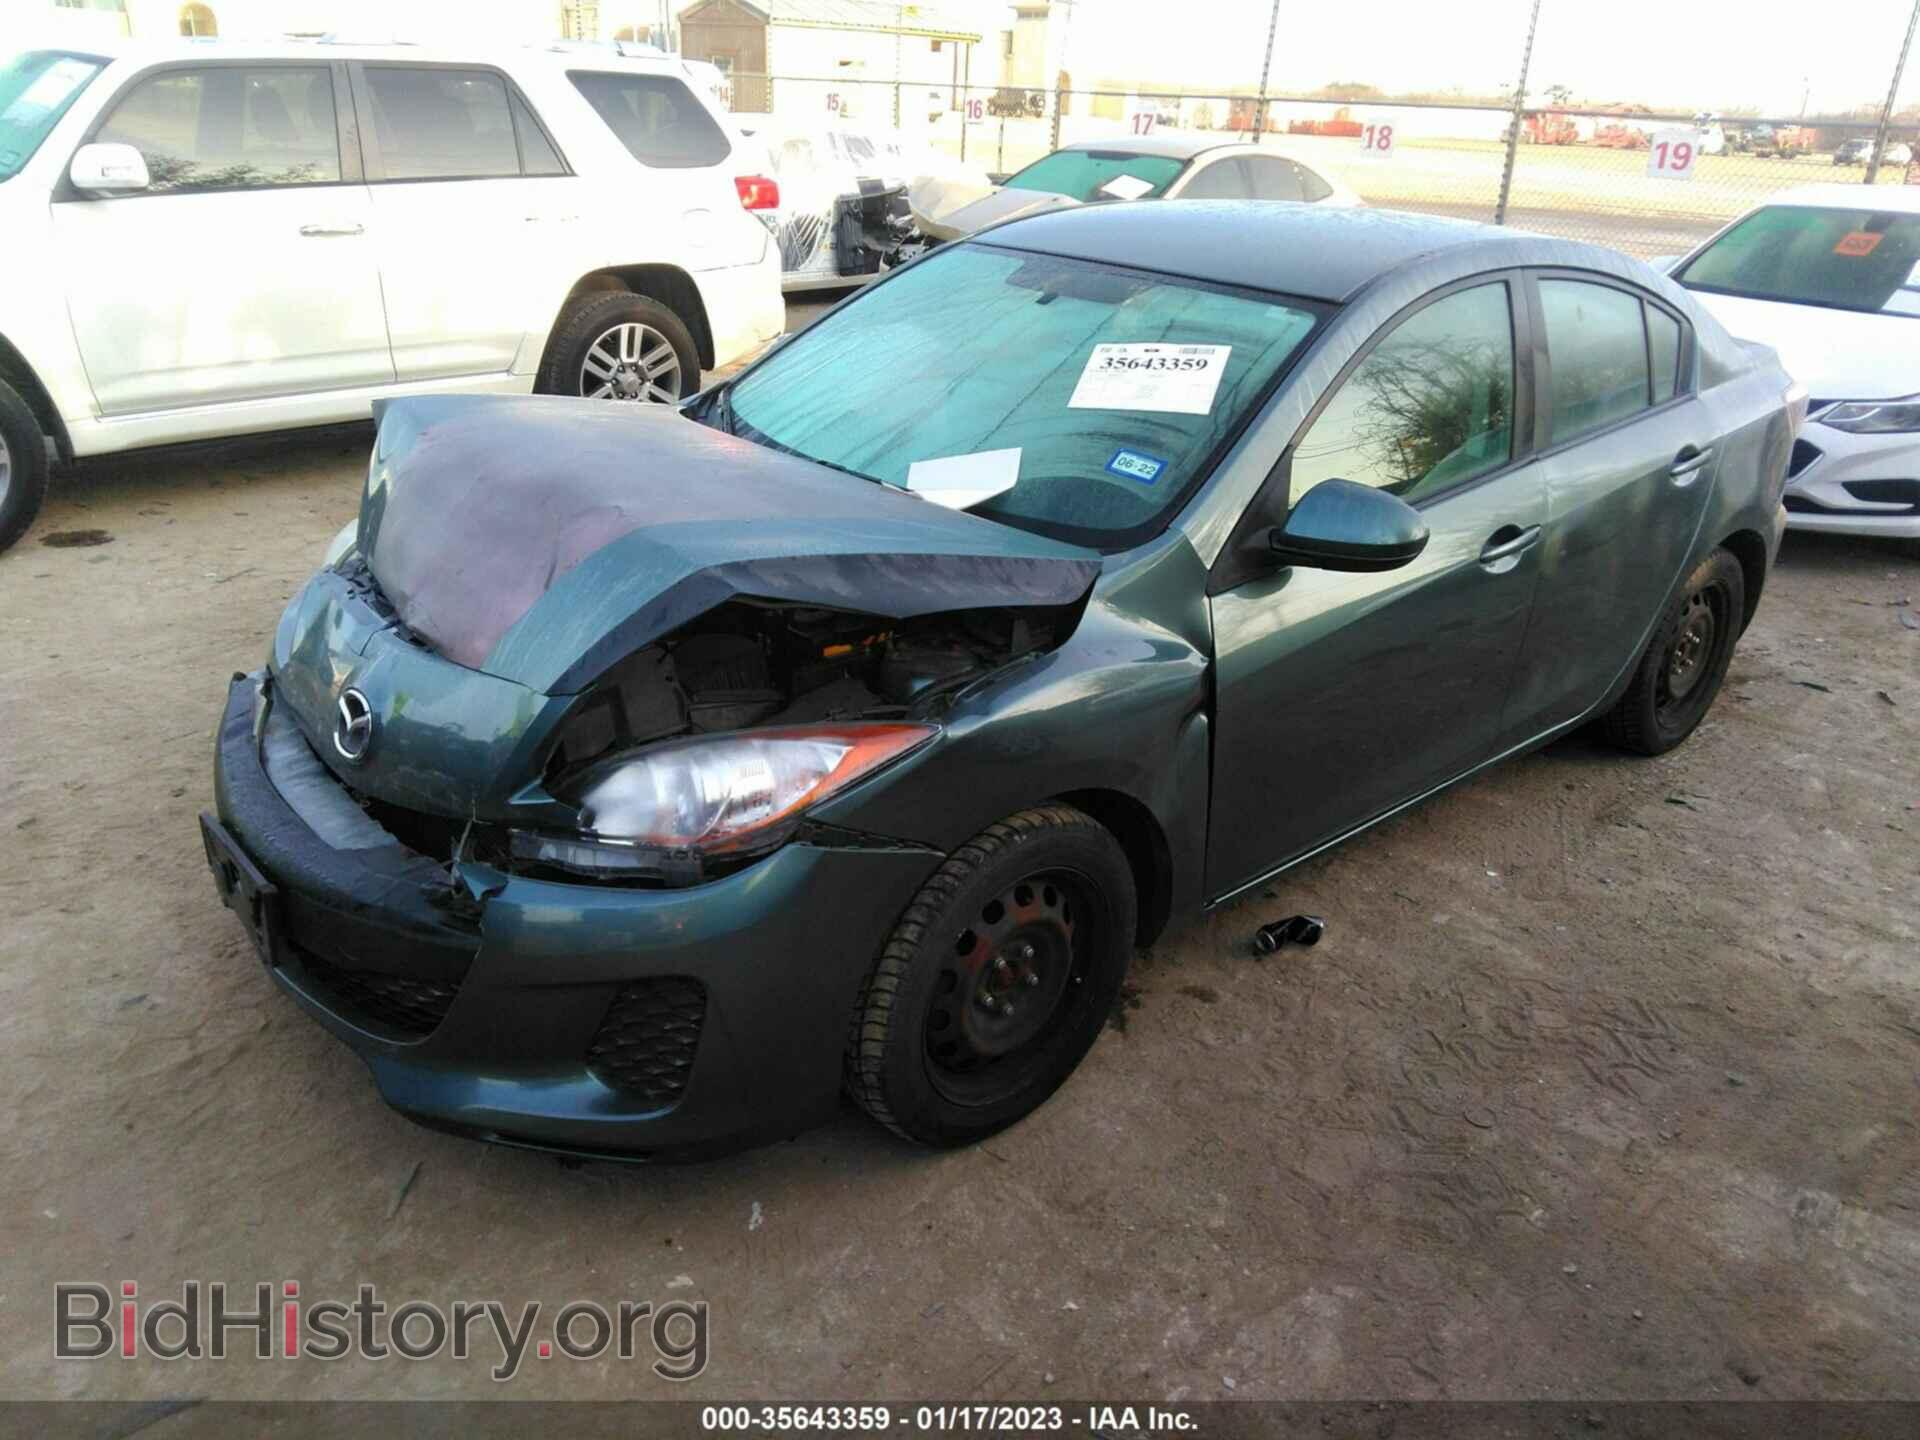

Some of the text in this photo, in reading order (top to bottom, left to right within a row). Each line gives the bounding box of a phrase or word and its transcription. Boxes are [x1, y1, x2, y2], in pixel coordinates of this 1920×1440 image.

[826, 92, 839, 111] 15
[966, 99, 983, 119] 16
[1132, 113, 1154, 135] 17
[1366, 125, 1392, 150] 18
[1655, 141, 1692, 170] 19
[1099, 356, 1208, 371] 35643359
[1117, 456, 1156, 475] 06-22
